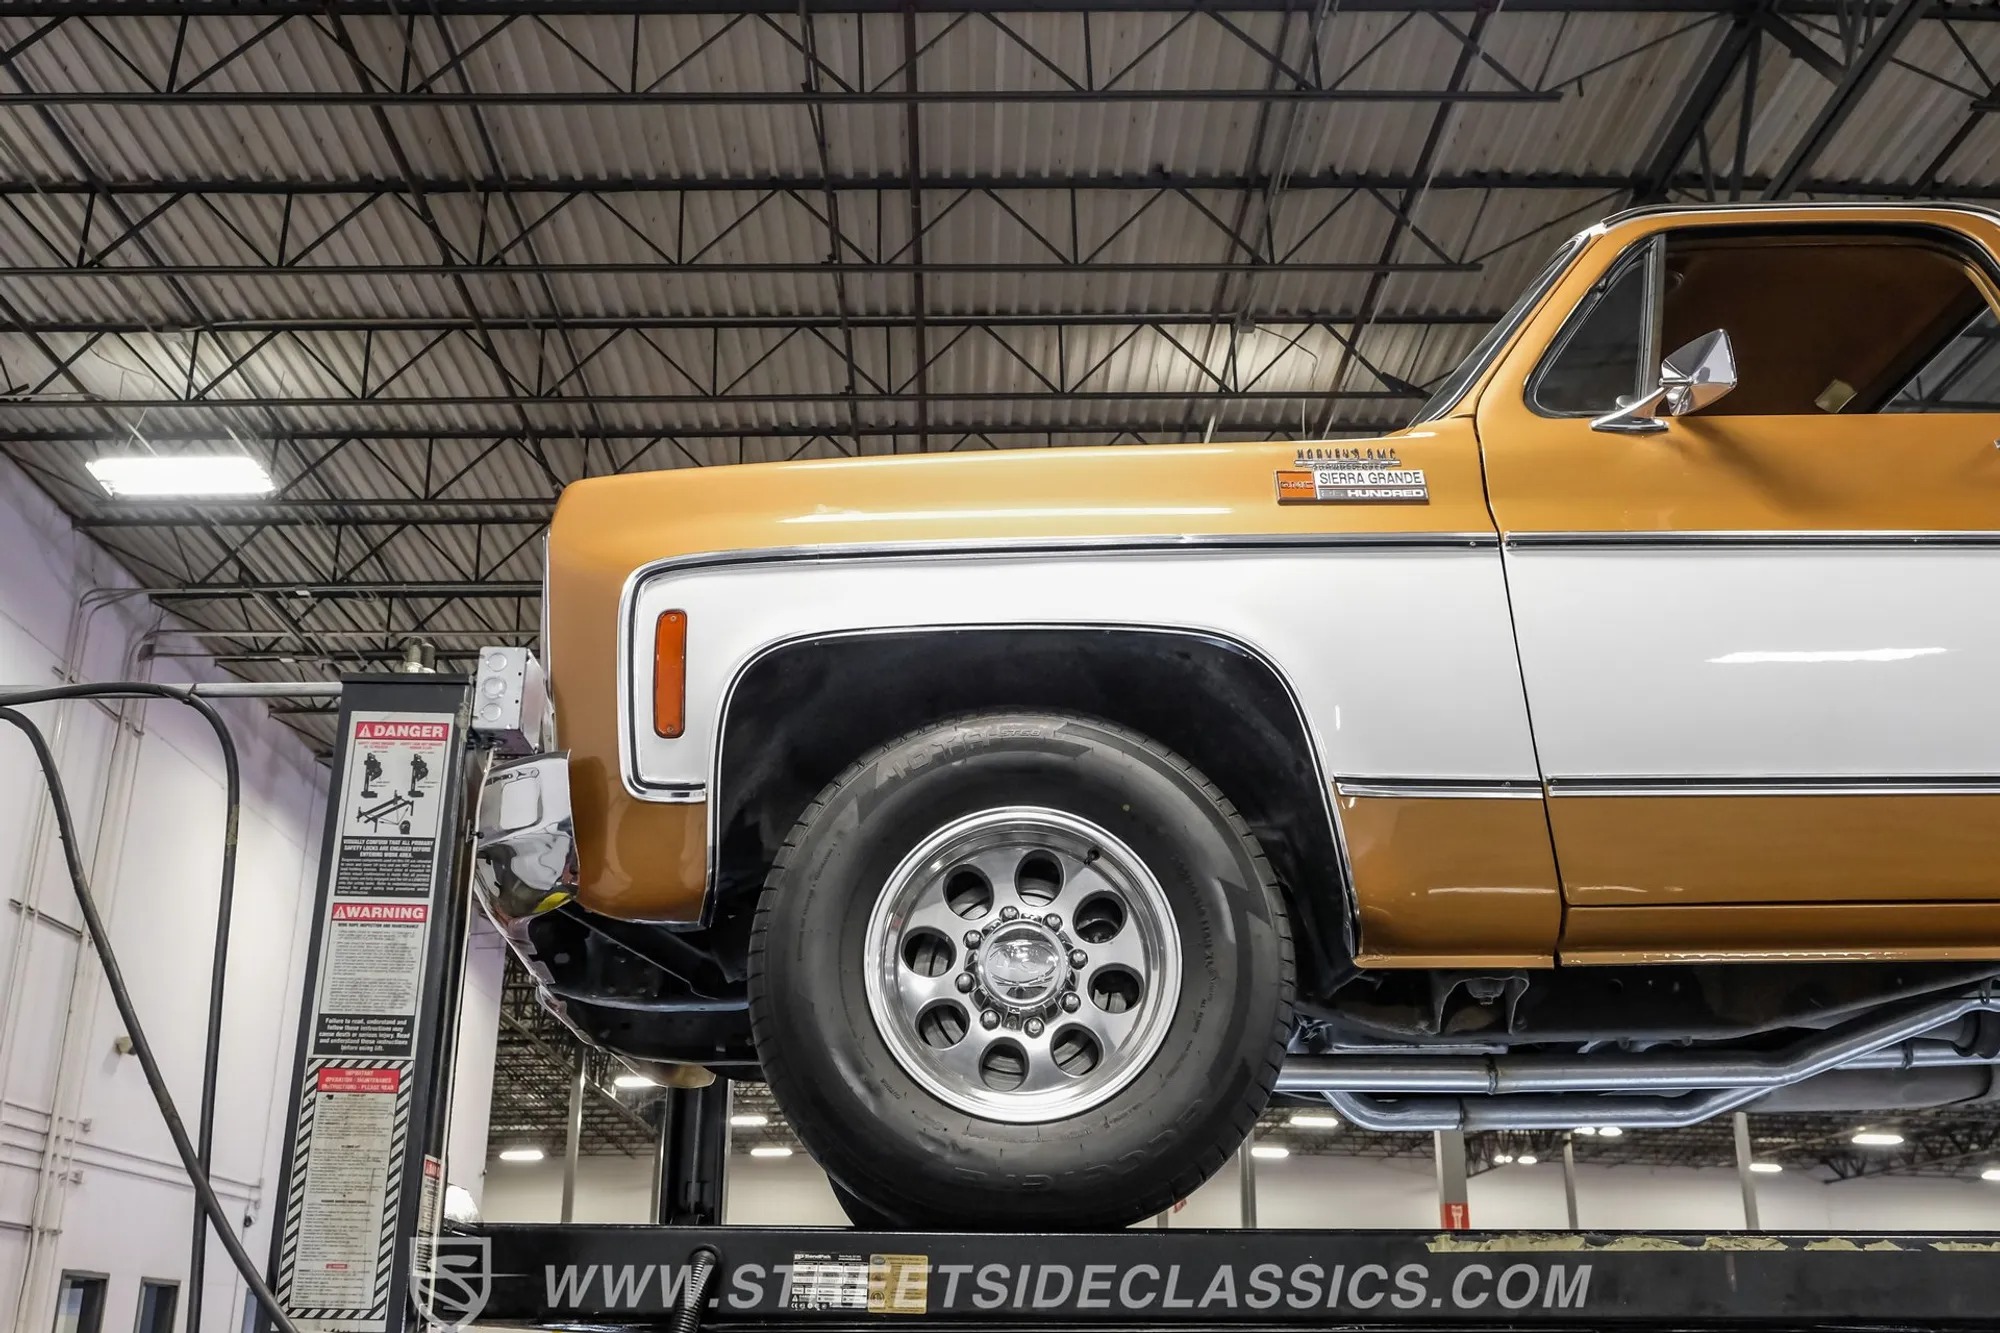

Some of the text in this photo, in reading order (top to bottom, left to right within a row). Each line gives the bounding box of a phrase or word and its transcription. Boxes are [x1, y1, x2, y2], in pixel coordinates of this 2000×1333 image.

[1320, 472, 1422, 484] SIERRA GRANDE
[374, 725, 444, 737] DANGER
[347, 906, 424, 918] WARNING
